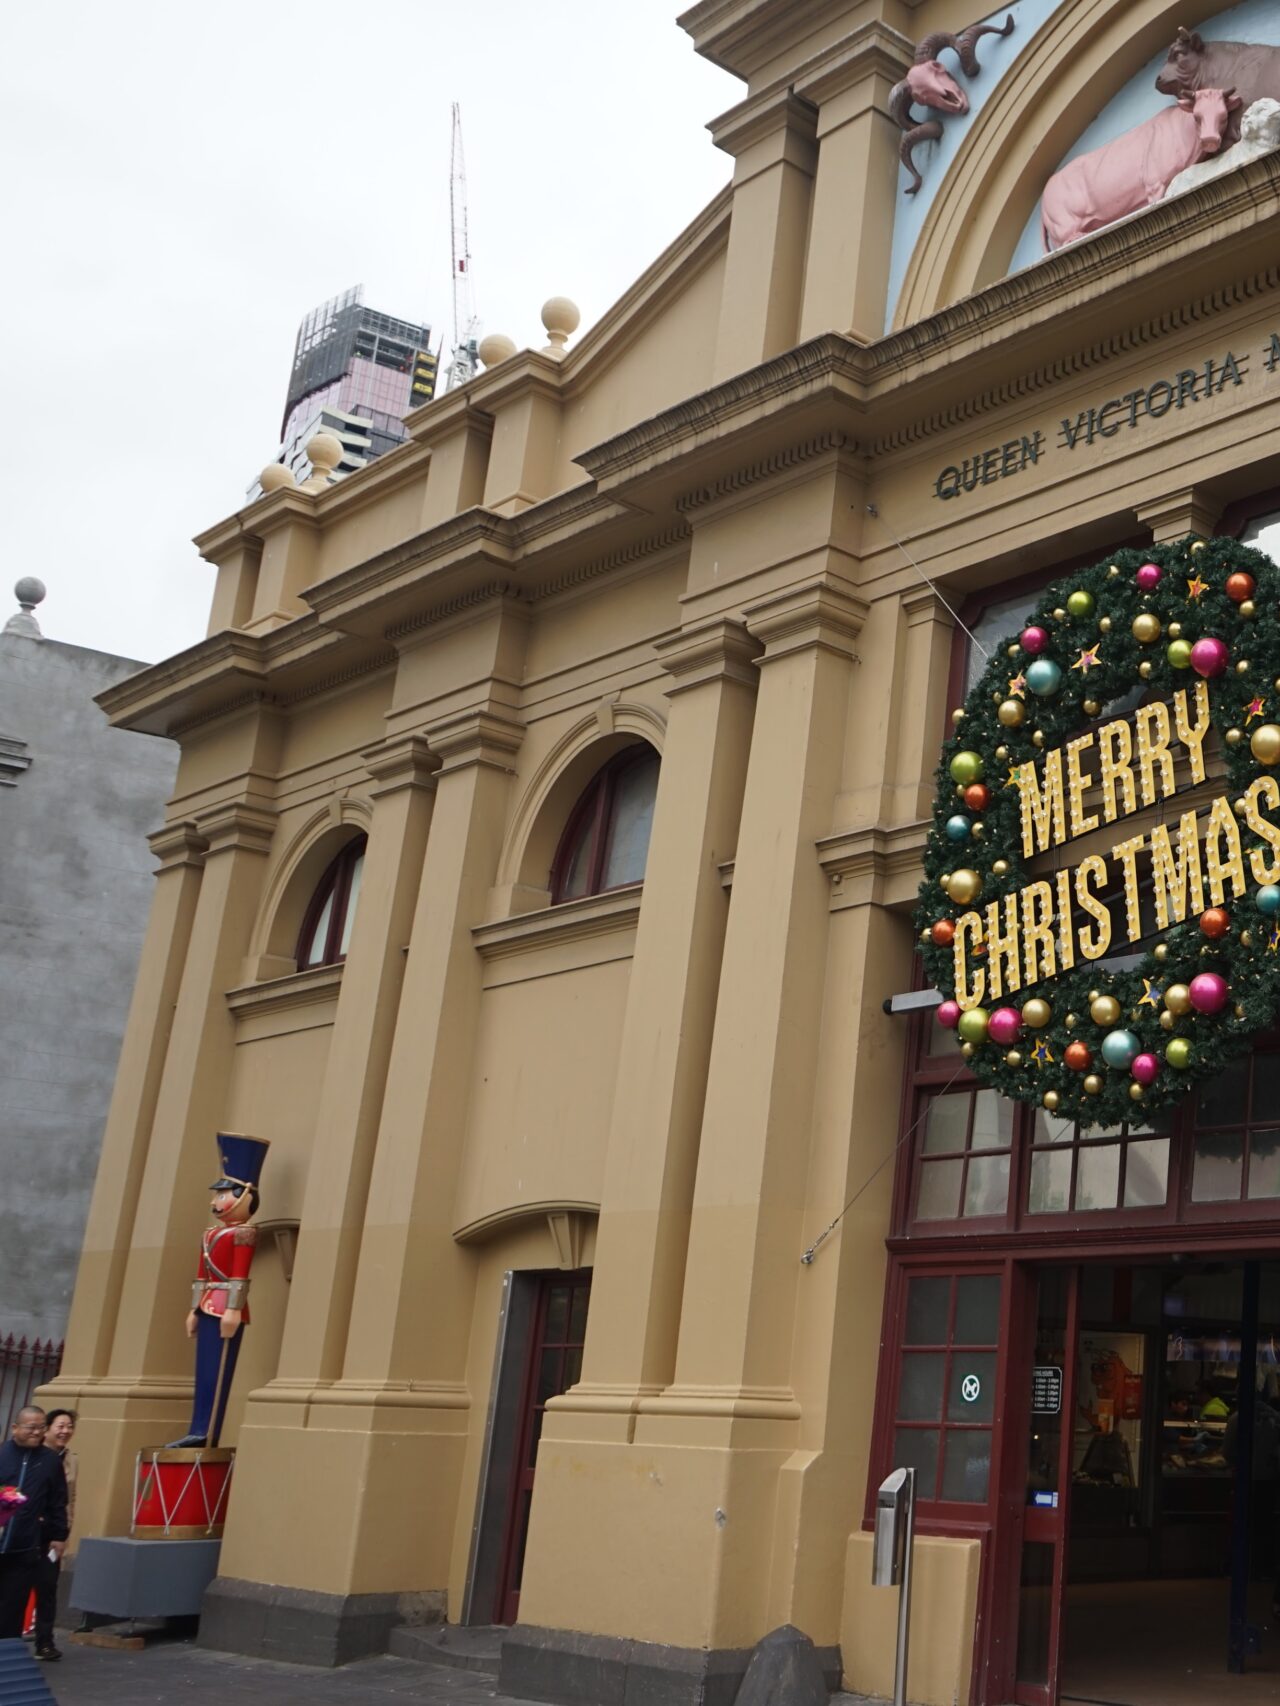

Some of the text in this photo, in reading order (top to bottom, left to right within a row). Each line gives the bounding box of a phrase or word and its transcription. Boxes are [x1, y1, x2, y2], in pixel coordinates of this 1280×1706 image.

[934, 431, 1043, 500] QUEEN
[1060, 352, 1243, 450] VICTORIA
[1018, 680, 1210, 859] MERRY
